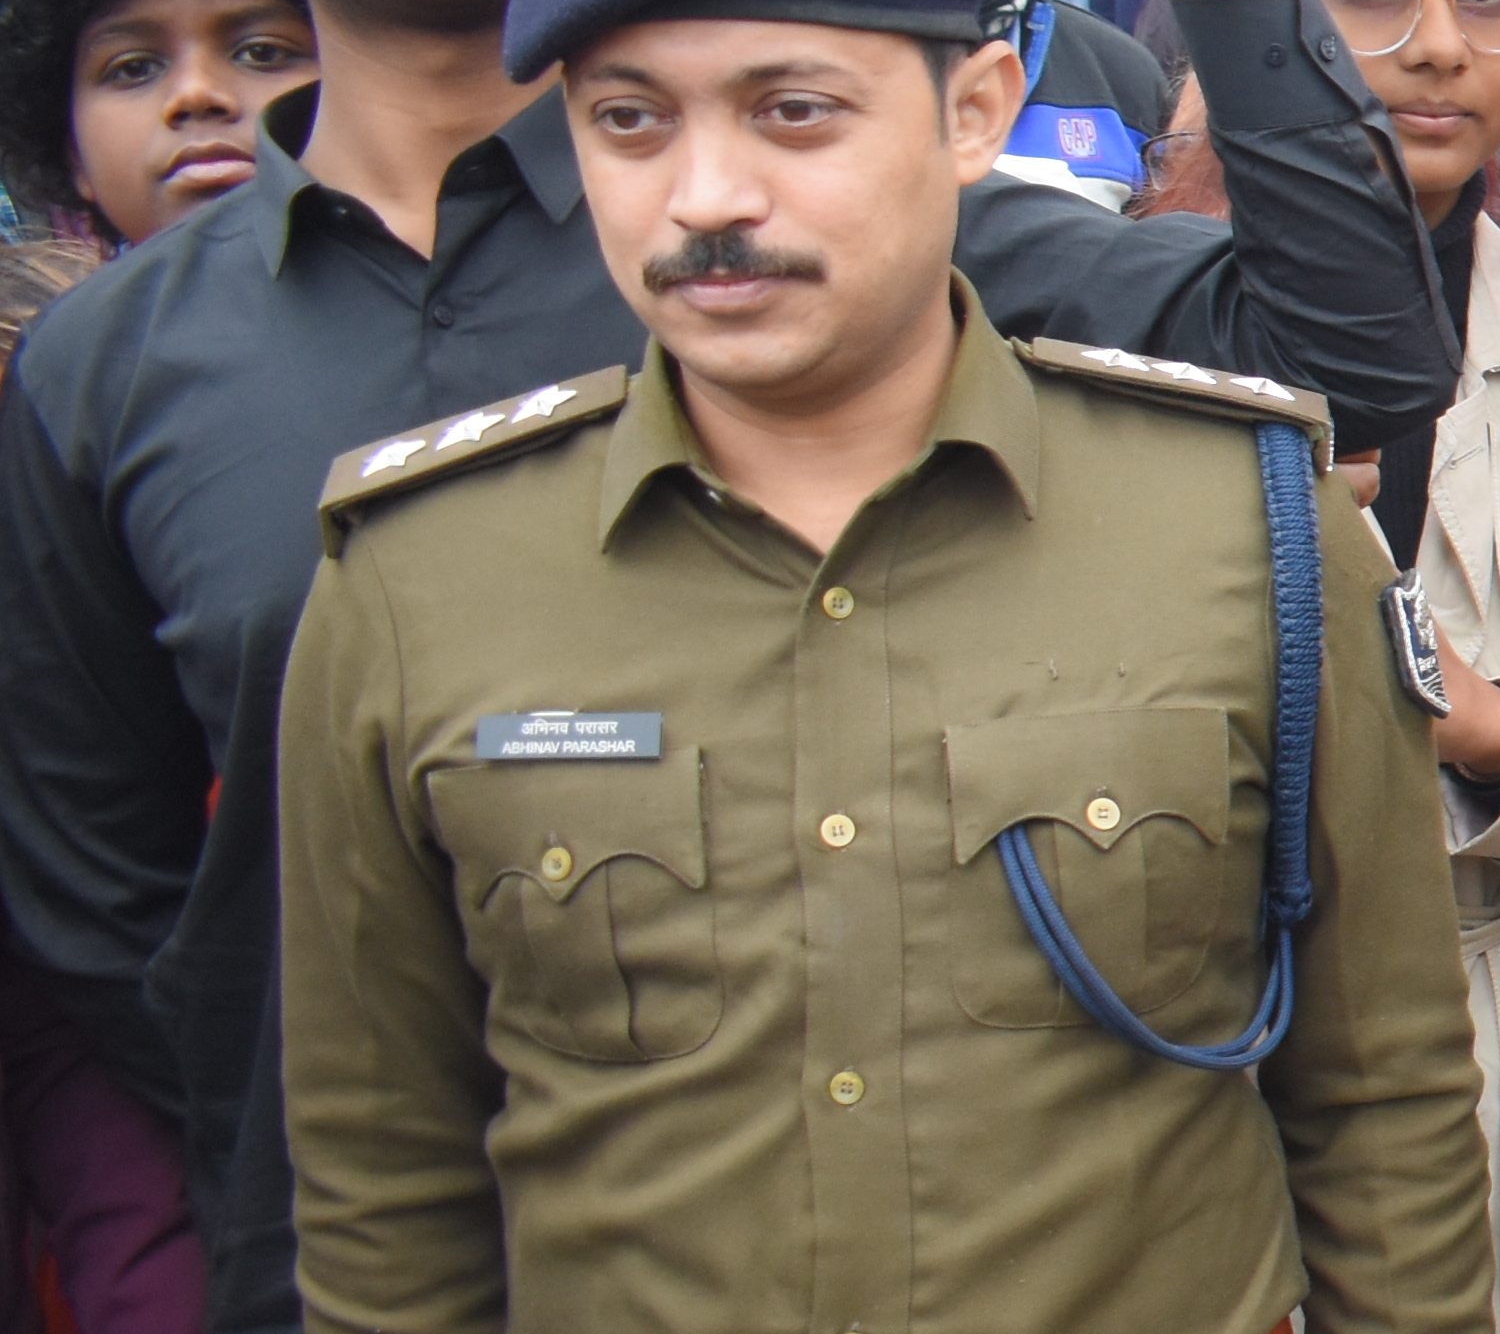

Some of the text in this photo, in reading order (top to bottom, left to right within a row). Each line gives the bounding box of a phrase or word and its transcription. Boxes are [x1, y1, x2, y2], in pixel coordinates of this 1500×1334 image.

[1058, 117, 1097, 157] GAP
[520, 718, 570, 736] अभिनव
[501, 739, 636, 755] ABHINAV PARASHAR
